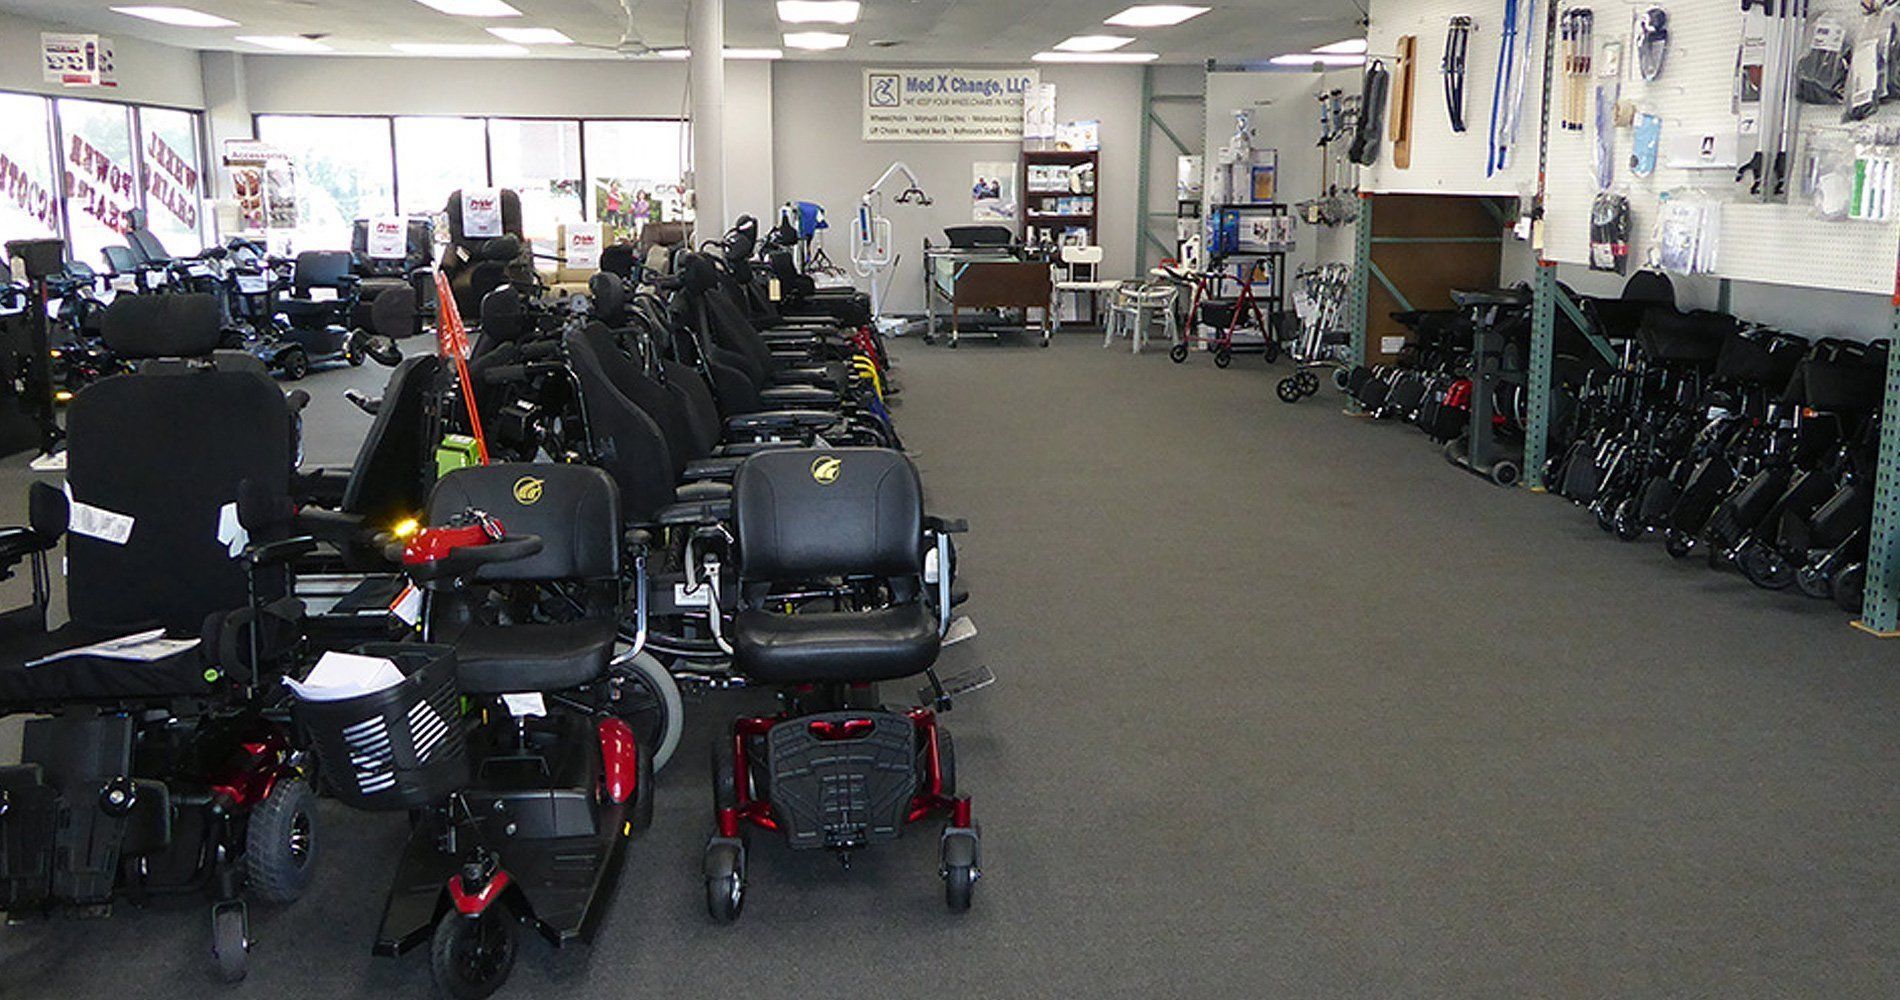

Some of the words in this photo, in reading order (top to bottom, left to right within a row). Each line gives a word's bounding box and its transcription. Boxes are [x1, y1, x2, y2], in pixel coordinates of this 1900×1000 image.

[906, 77, 934, 93] Med
[937, 75, 948, 93] X
[951, 76, 1004, 97] Change,
[232, 150, 289, 160] Accessories
[470, 199, 494, 208] Pride
